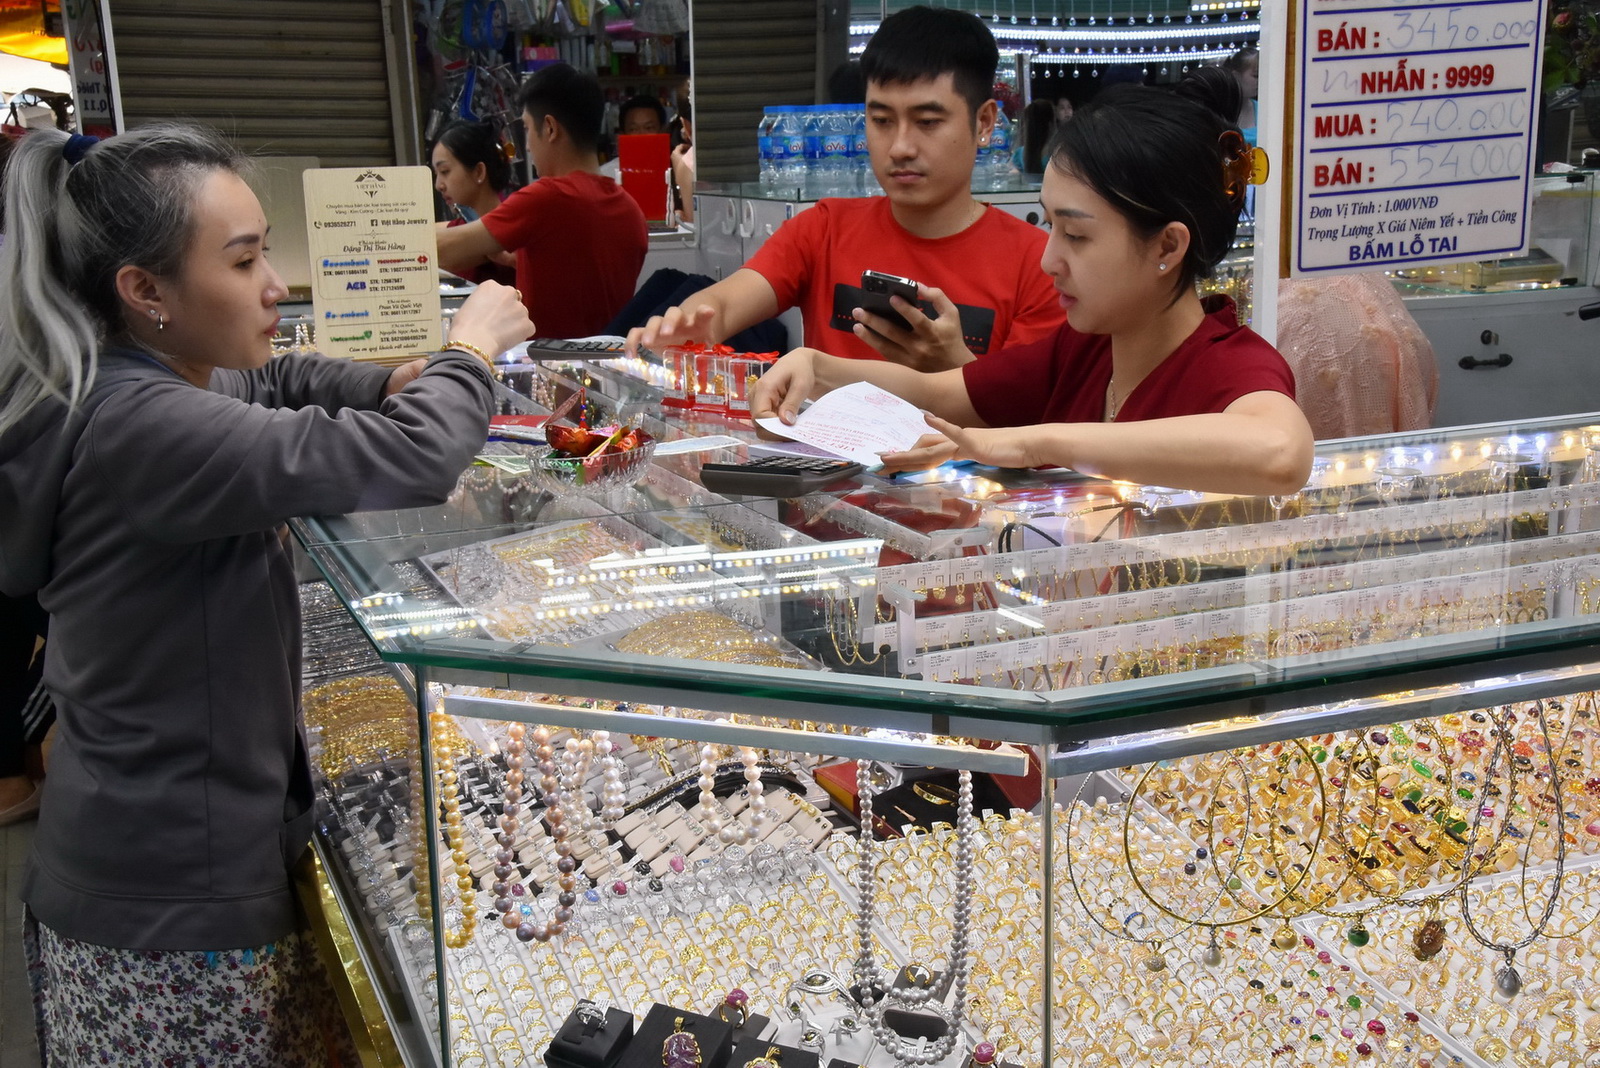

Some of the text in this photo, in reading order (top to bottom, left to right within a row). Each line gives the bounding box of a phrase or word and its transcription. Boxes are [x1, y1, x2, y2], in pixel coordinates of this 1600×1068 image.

[1317, 22, 1367, 52] BÁN
[1361, 59, 1425, 94] NHẪN
[1445, 64, 1494, 89] 9999
[1314, 114, 1363, 138] MUA
[1314, 158, 1363, 187] BÁN
[1309, 205, 1332, 219] Đơn
[1336, 203, 1348, 219] Vị
[1351, 201, 1375, 216] Tính
[1384, 196, 1439, 214] 1.000VNĐ
[1308, 227, 1338, 242] Trọng
[1341, 223, 1374, 239] Lượng
[1376, 221, 1385, 234] X
[1388, 219, 1406, 233] Giá
[1409, 216, 1436, 231] Niêm
[1439, 213, 1454, 228] Yết
[1467, 209, 1489, 226] Tiền
[1491, 209, 1517, 224] Công
[343, 245, 361, 253] Đặng
[363, 244, 373, 252] Thị
[388, 242, 406, 251] Hằng
[1348, 232, 1457, 261] BẤM LỖ TAI
[346, 281, 367, 291] ACB
